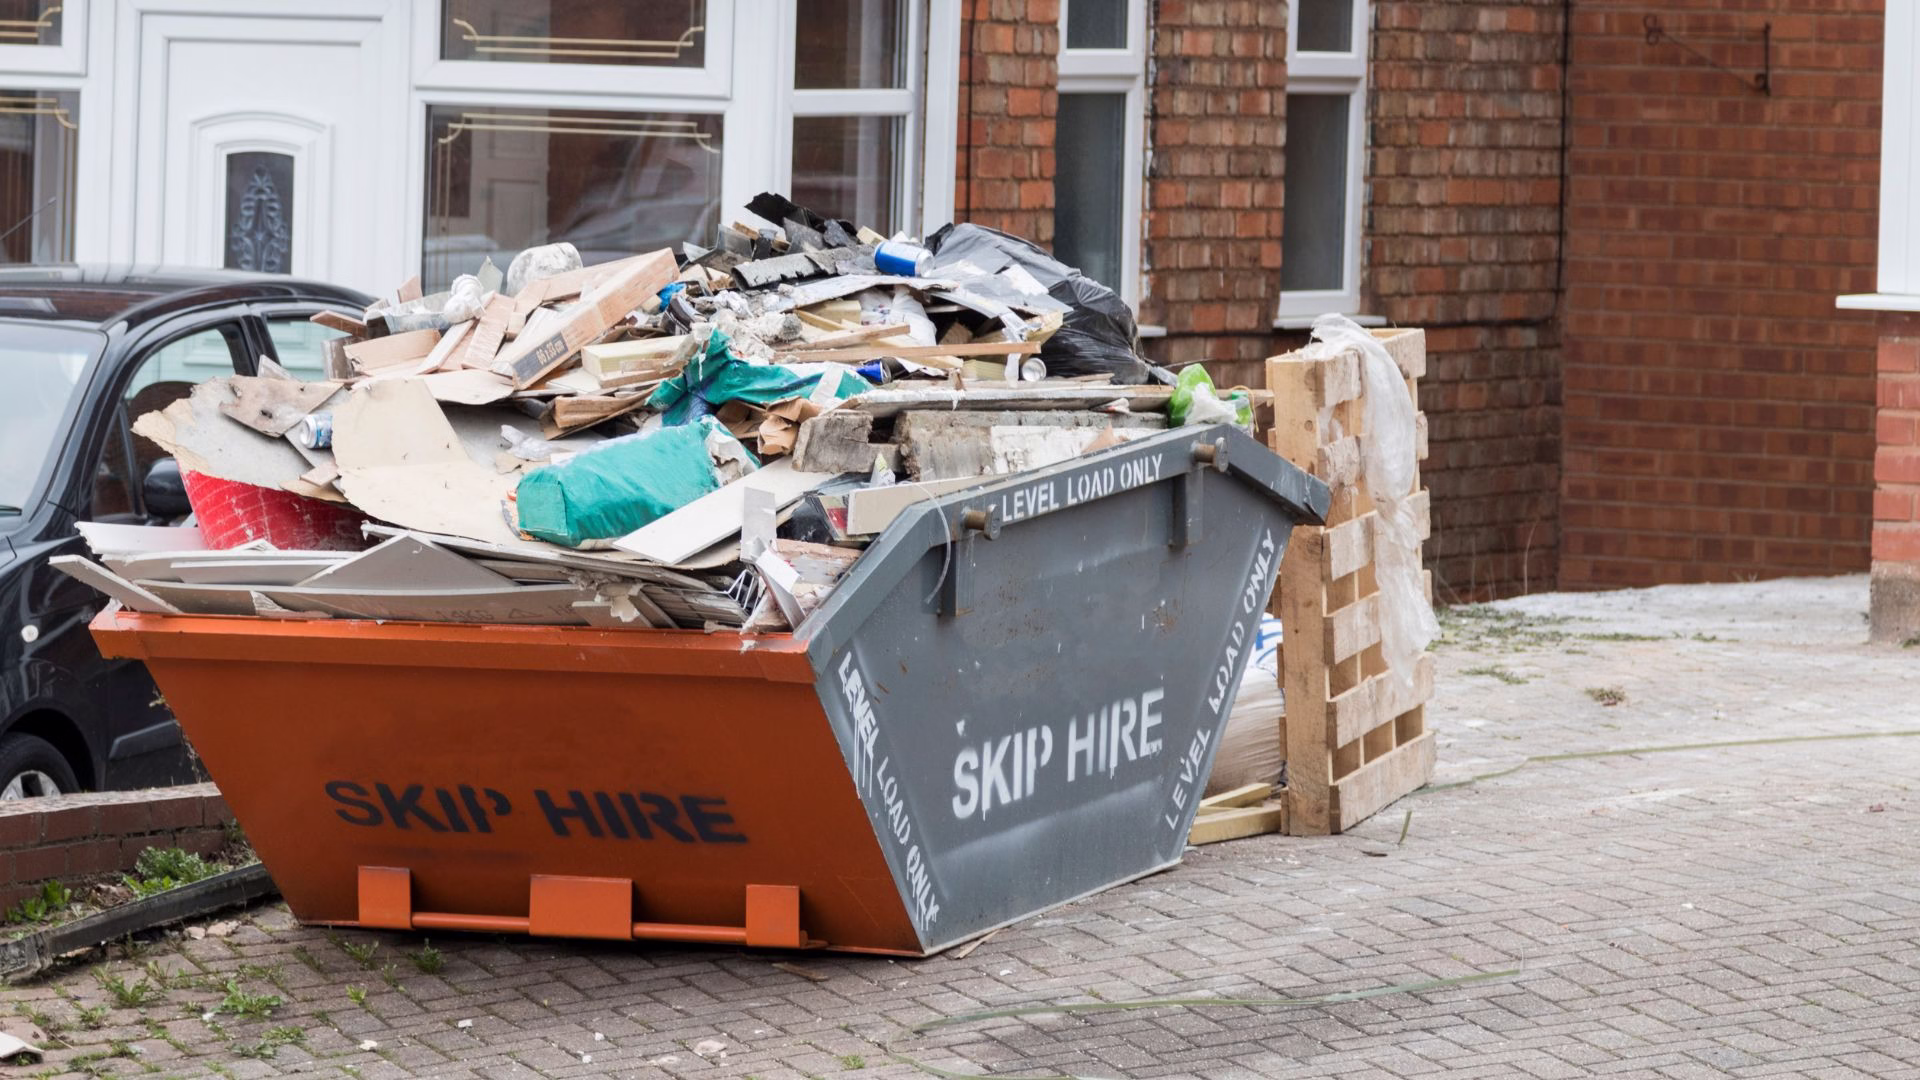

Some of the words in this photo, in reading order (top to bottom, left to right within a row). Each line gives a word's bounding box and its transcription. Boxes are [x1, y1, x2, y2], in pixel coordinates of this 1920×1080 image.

[1002, 481, 1060, 522] LEVEL
[1067, 470, 1115, 505] LOAD
[1120, 453, 1163, 489] ONLY
[1165, 728, 1211, 830] LEVEL
[1208, 620, 1246, 715] LOAD
[1243, 528, 1275, 614] ONLY
[324, 780, 512, 834] SKIP
[533, 788, 749, 844] HIRE
[838, 651, 880, 768] LEVEL
[876, 756, 911, 845] LOAD
[906, 845, 940, 928] ONLY
[952, 724, 1054, 820] SKIP
[1066, 687, 1165, 782] HIRE
